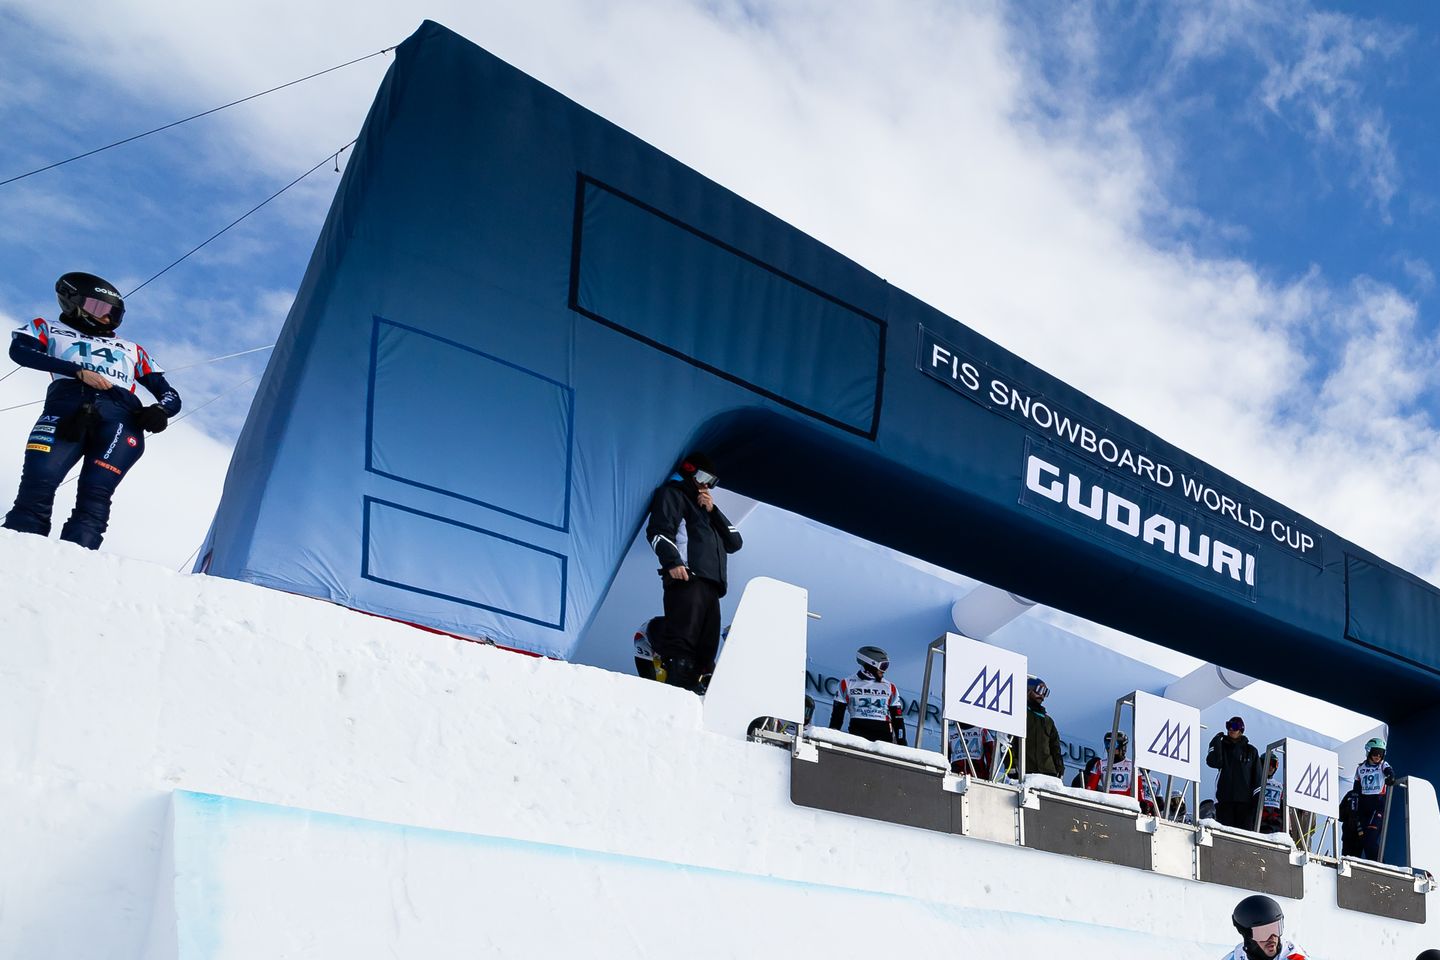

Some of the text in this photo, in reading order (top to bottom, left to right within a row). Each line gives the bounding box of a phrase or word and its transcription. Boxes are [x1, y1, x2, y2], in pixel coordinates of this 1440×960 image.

[72, 341, 117, 363] 14
[932, 344, 1314, 553] FIS SNOWBOARD WORLD CUP
[1025, 454, 1255, 587] GUDAURI
[1362, 774, 1375, 785] 19
